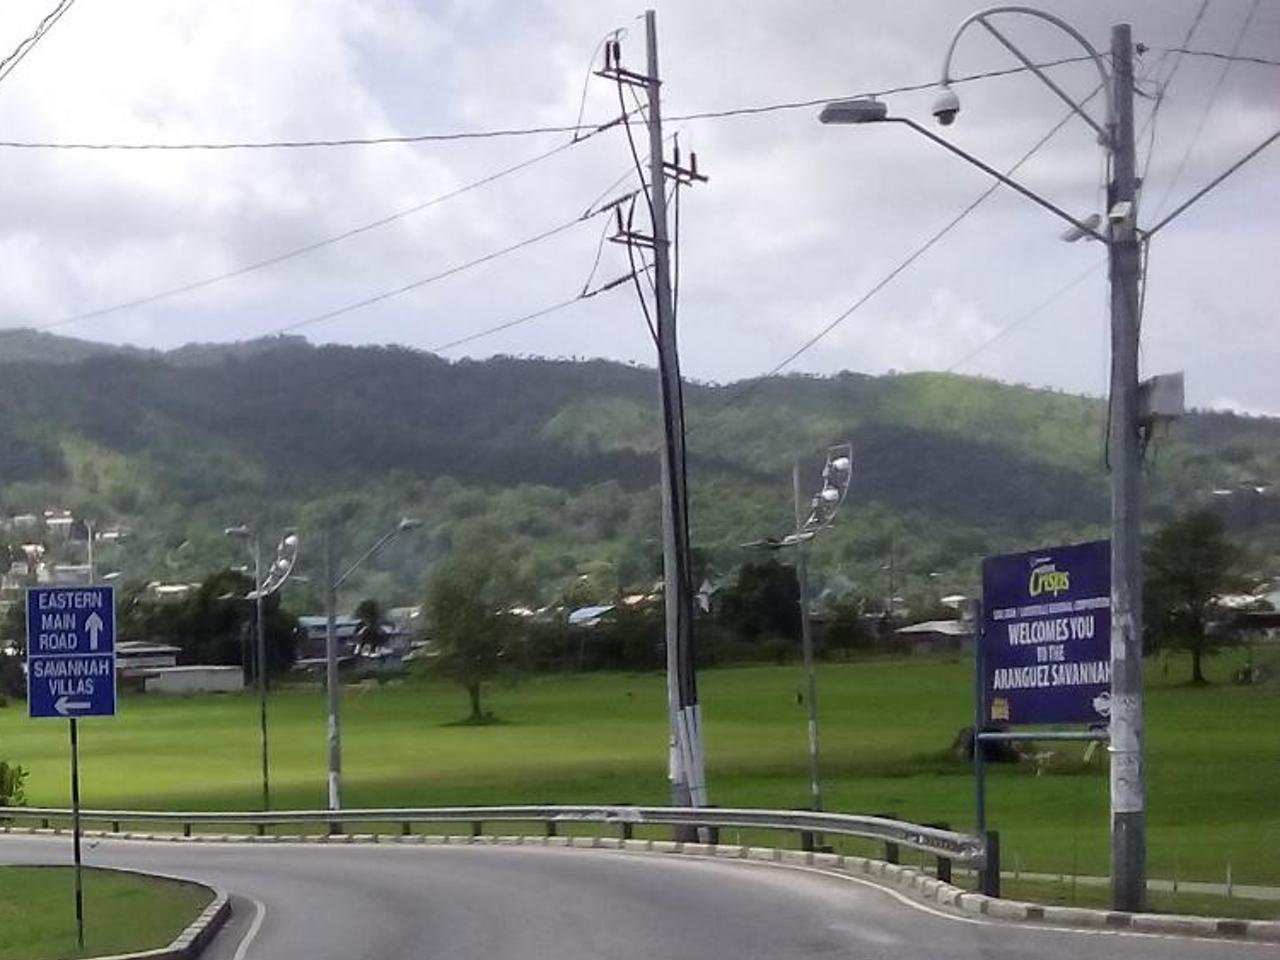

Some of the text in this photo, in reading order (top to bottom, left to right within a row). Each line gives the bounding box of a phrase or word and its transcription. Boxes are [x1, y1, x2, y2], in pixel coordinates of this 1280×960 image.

[39, 591, 102, 609] EASTERN
[41, 613, 76, 630] MAIN
[1008, 615, 1095, 645] WELCOMES YOU
[39, 633, 77, 650] ROAD
[34, 659, 109, 677] SAVANNAH
[993, 664, 1050, 690] ARANGUEZ
[48, 678, 94, 695] VILLAS
